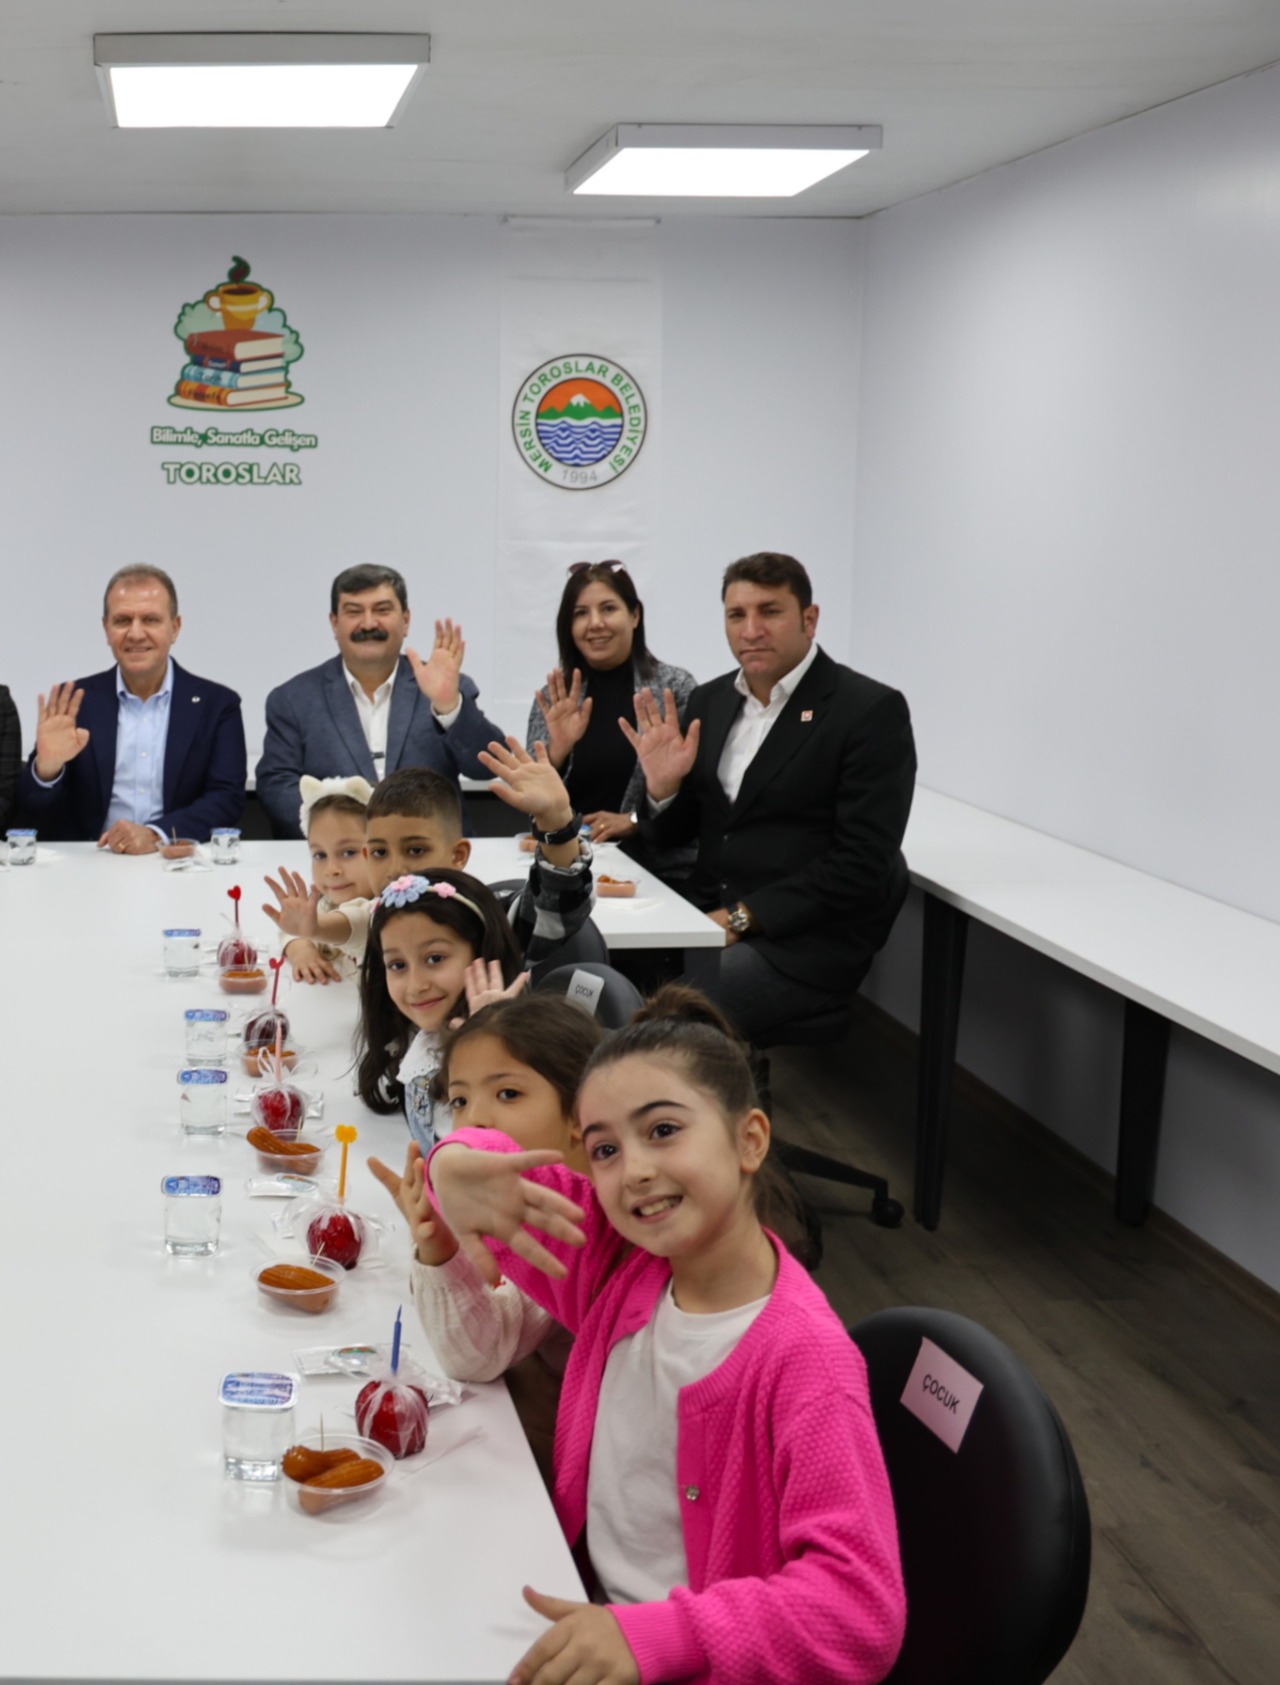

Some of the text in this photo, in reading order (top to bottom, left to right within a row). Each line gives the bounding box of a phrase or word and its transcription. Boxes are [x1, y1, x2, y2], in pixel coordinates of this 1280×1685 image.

[516, 360, 642, 474] MERSİN TOROSLAR BELEDİYESİ
[151, 426, 317, 451] Bilimle, Sanatla Gelişen
[161, 461, 302, 485] TOROSLAR
[562, 469, 598, 484] 1994
[922, 1373, 960, 1415] ÇOCUK
